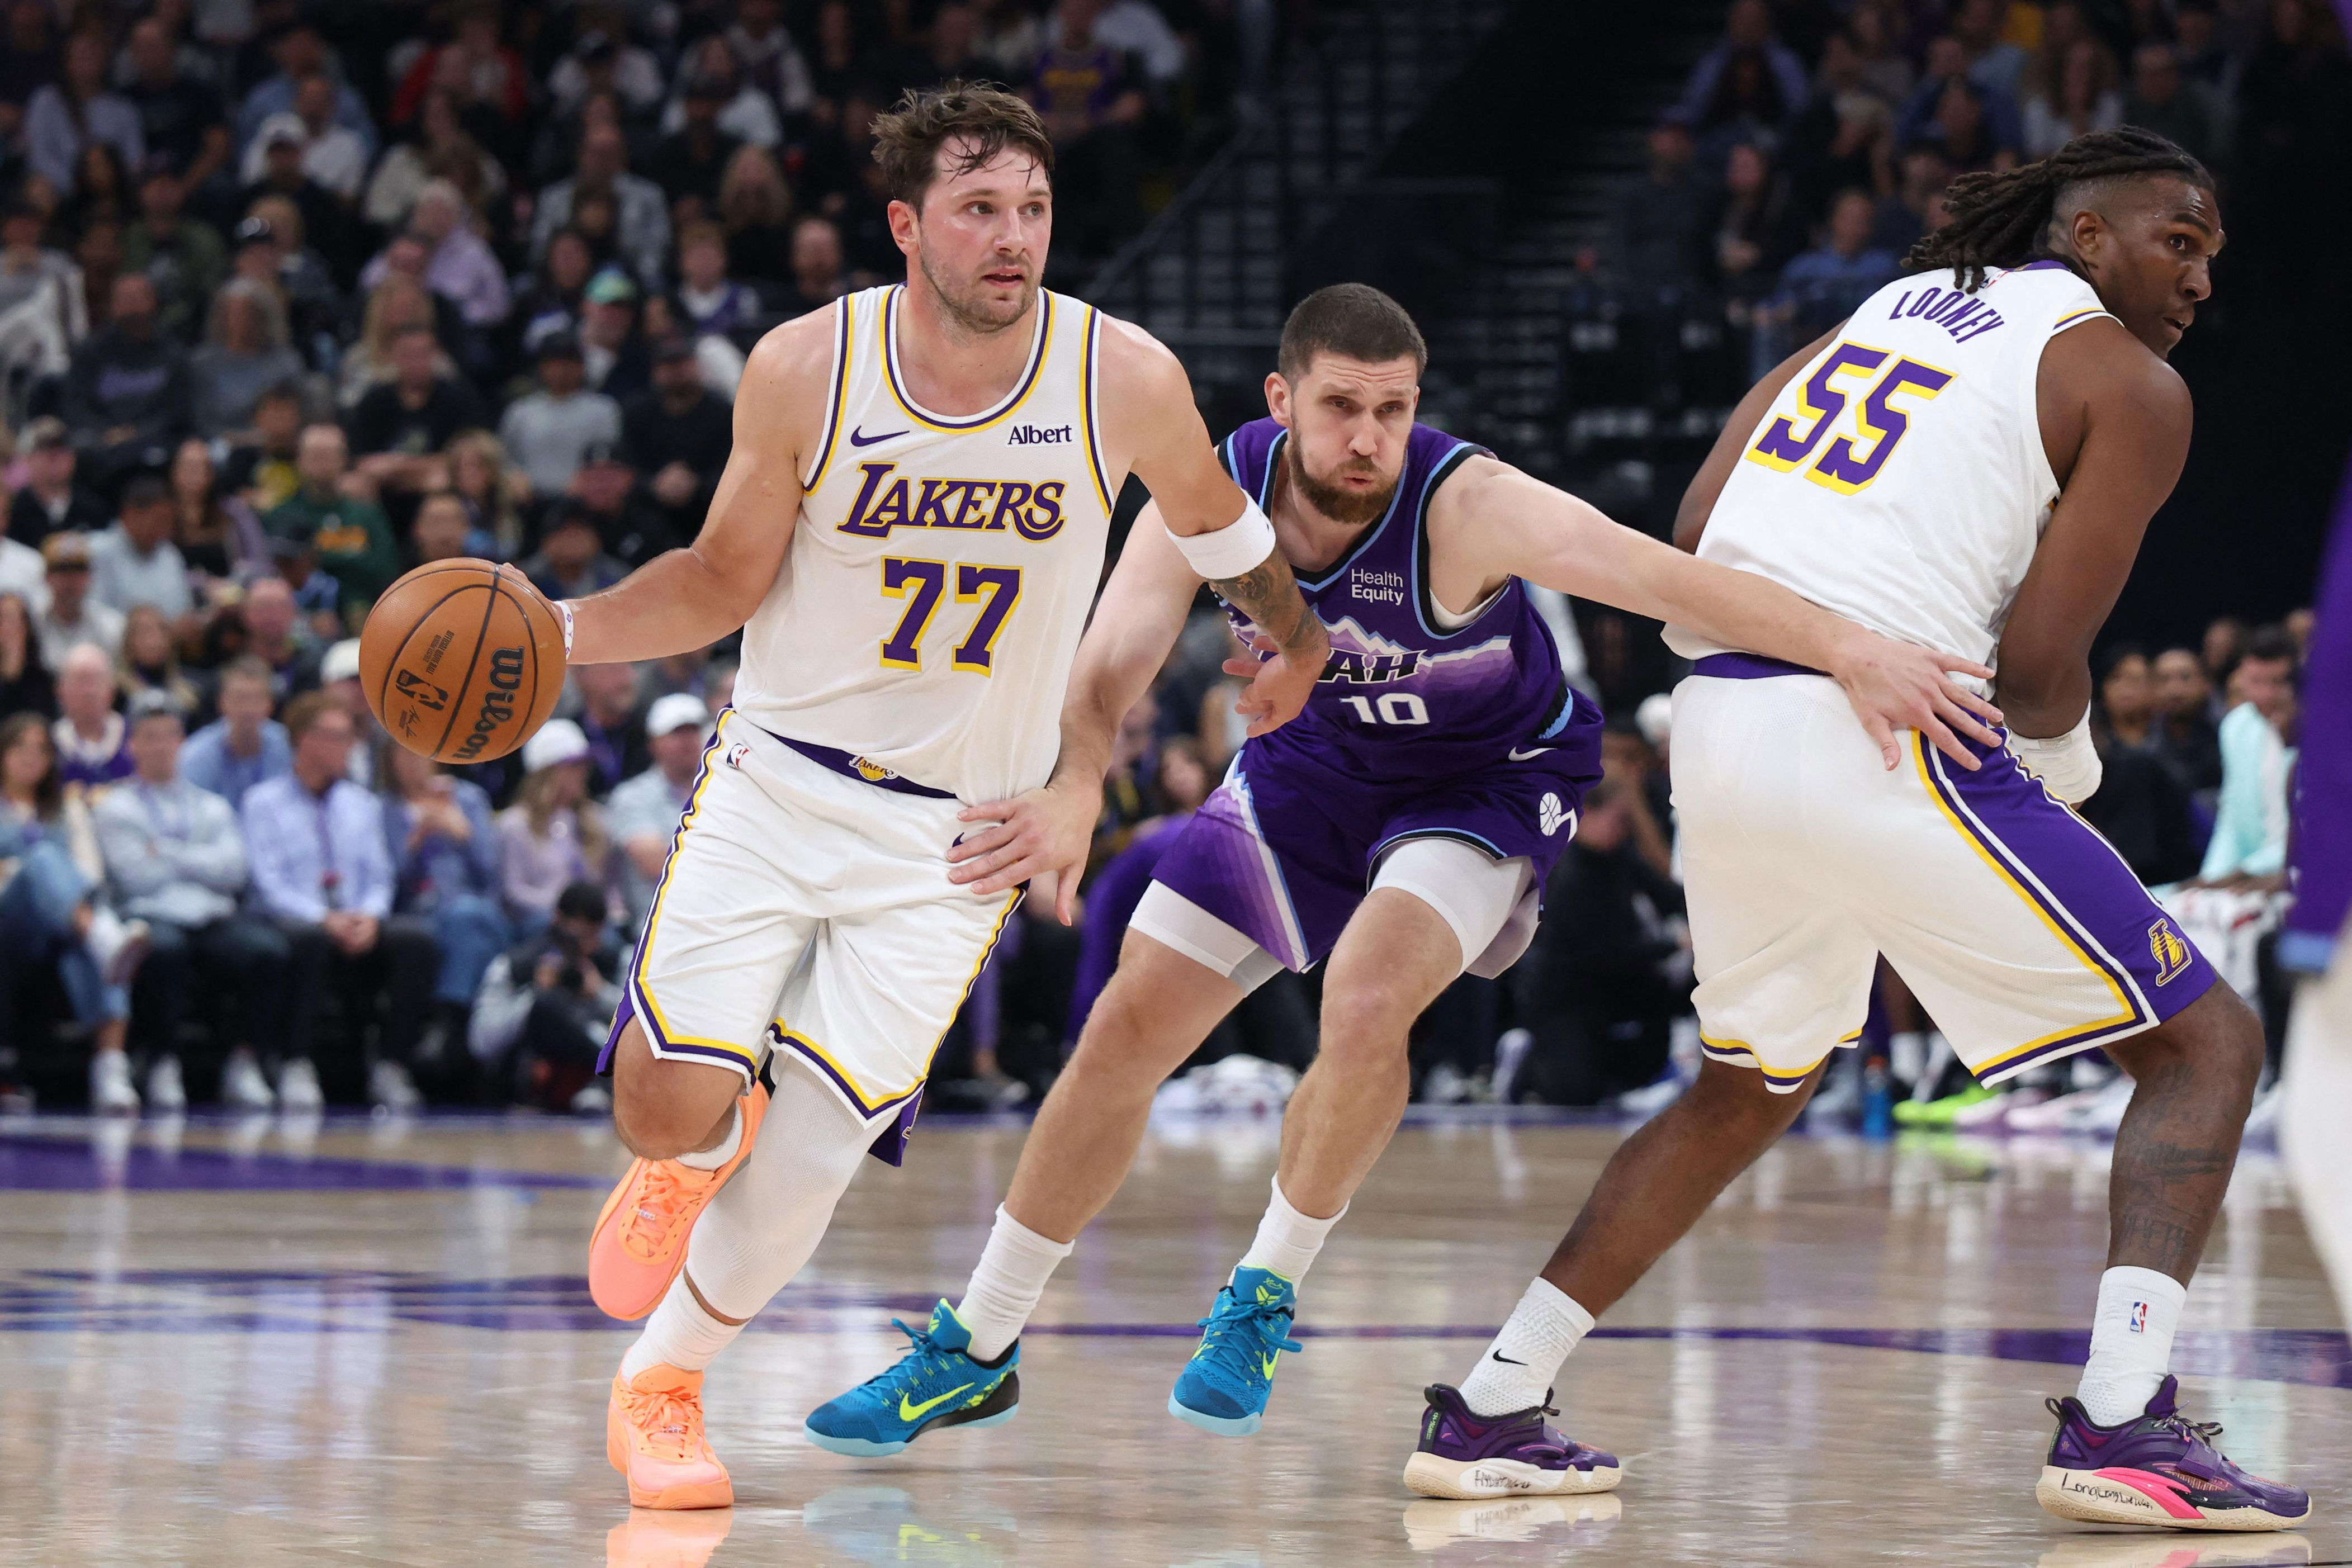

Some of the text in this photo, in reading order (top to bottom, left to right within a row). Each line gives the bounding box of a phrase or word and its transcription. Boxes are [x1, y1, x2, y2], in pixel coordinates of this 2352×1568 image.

[1889, 287, 2004, 344] LOONEY
[1008, 424, 1072, 445] Albert
[1745, 339, 1959, 496] 55
[834, 461, 1068, 543] LAKERS
[1351, 568, 1403, 588] Health
[1351, 584, 1404, 606] Equity
[879, 555, 1024, 678] 77
[1317, 647, 1428, 684] AH
[452, 646, 525, 760] Wilson
[1339, 693, 1431, 725] 10
